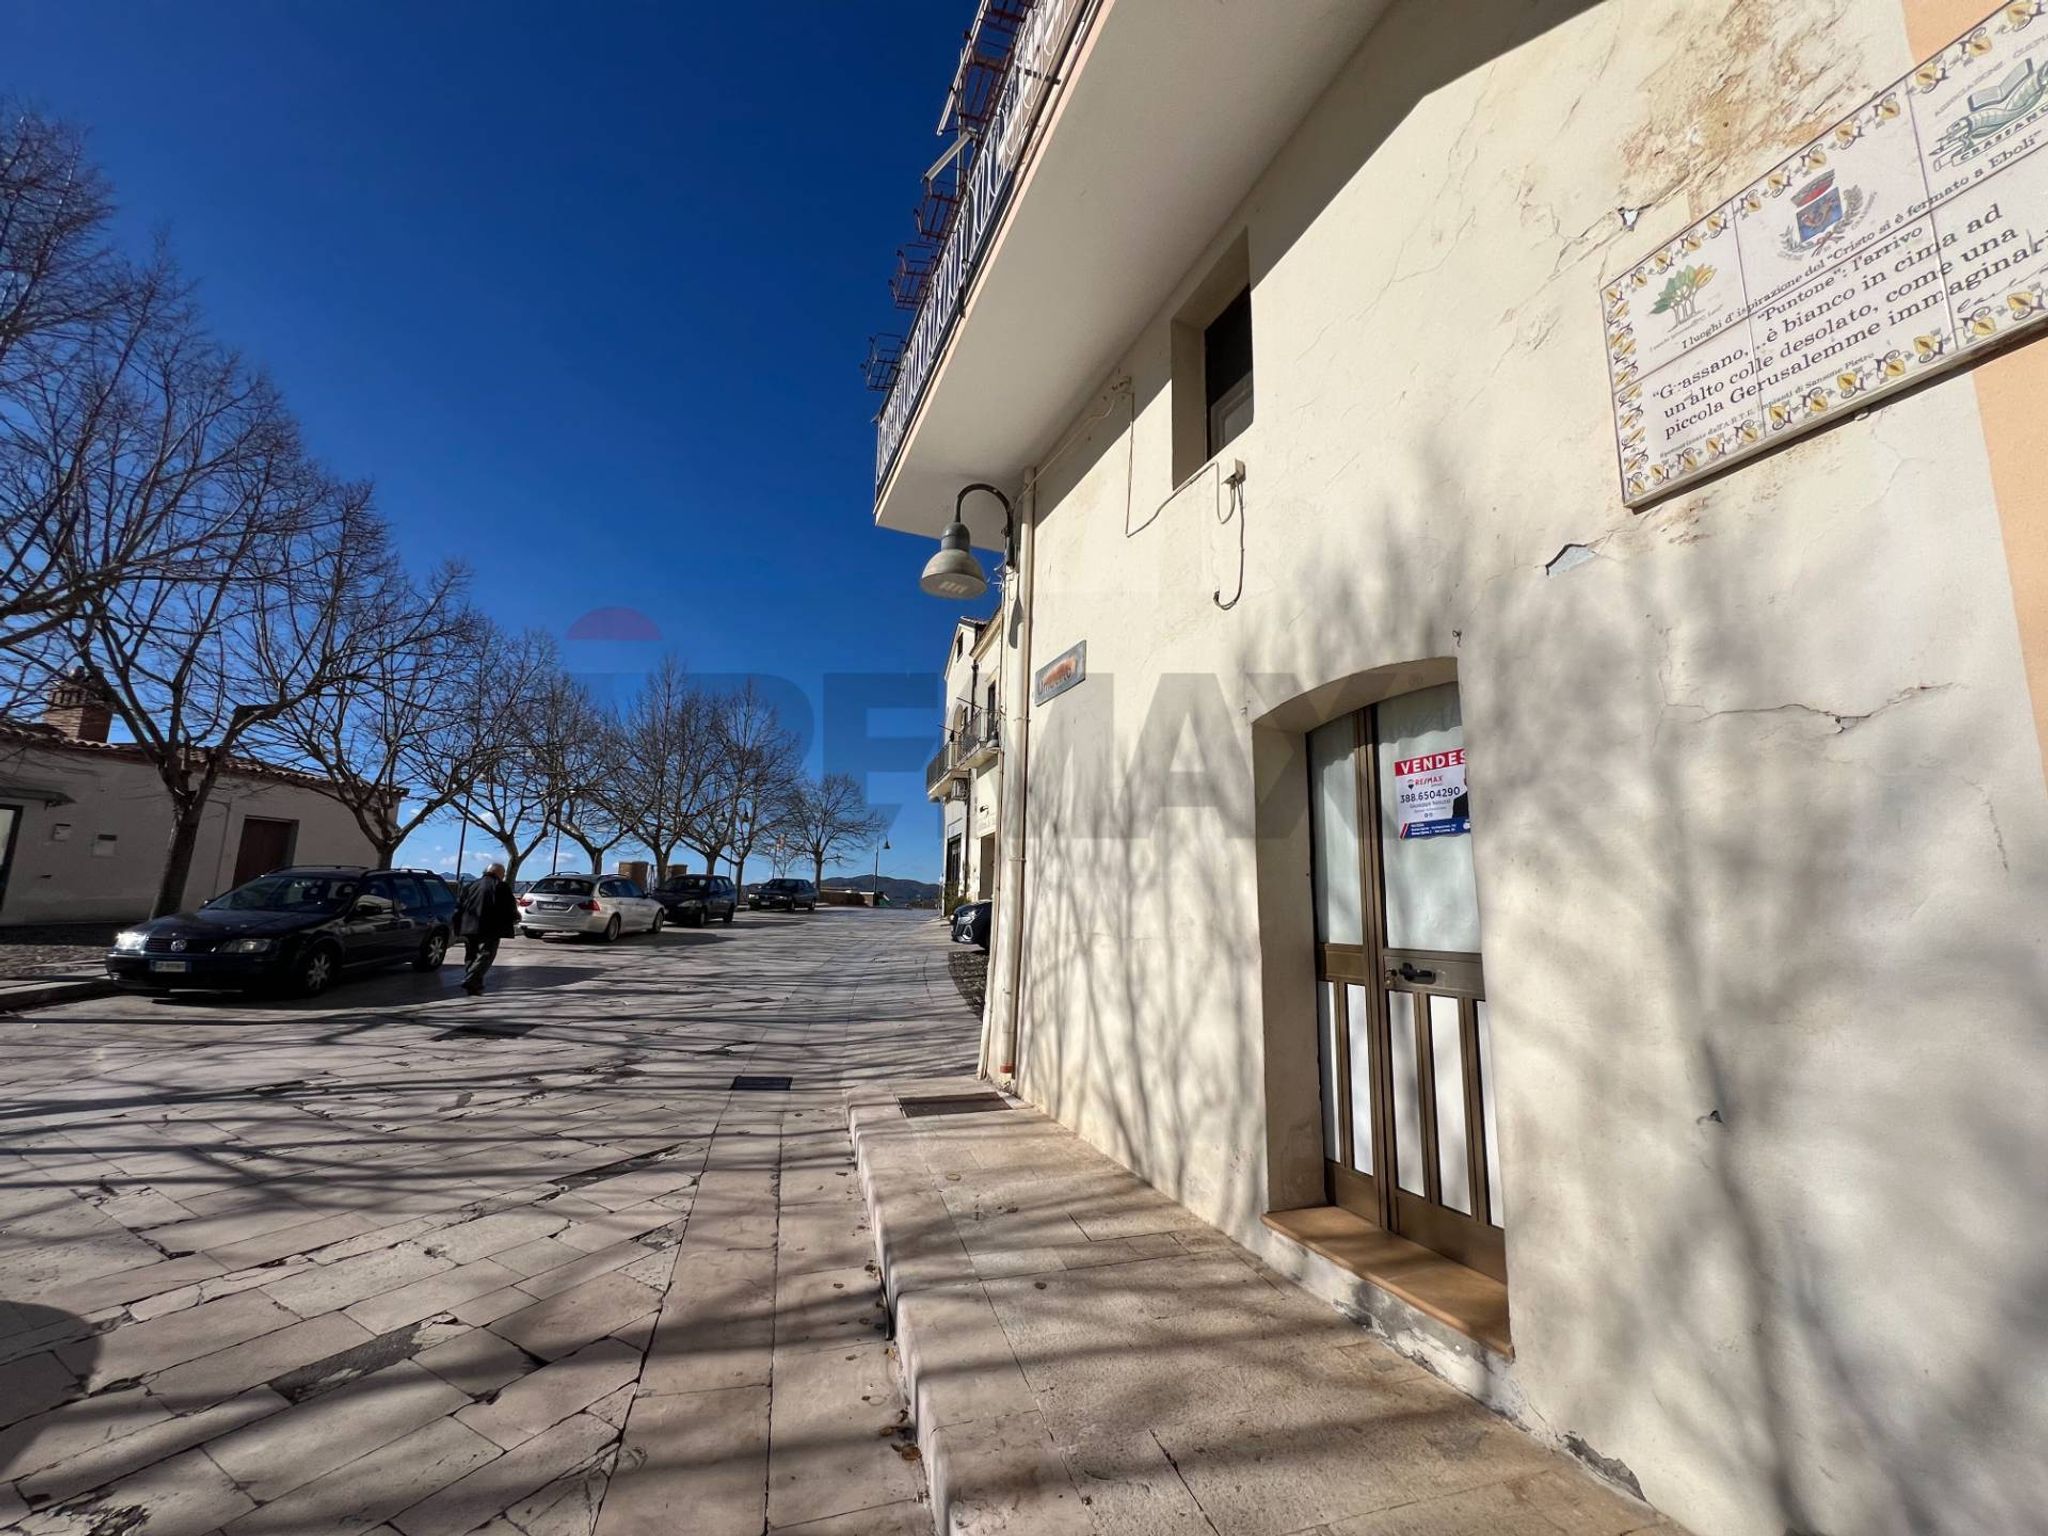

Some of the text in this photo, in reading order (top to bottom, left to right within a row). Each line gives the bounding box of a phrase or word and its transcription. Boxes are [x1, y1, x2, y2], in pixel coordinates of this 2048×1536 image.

[1689, 320, 1723, 345] luoghi
[1737, 274, 1802, 315] ispirazione
[1804, 259, 1825, 277] del
[1879, 219, 1891, 234] si
[1894, 213, 1904, 224] è
[1907, 177, 1970, 217] fermato
[1974, 168, 1984, 178] a
[1729, 355, 1774, 384] colle
[1780, 303, 1879, 358] desolato,
[1886, 262, 1953, 303] come
[1960, 229, 2019, 262] una
[1783, 287, 1855, 334] bianco
[1860, 271, 1887, 291] in
[1894, 232, 1959, 273] cima
[1967, 203, 2003, 234] ad
[1852, 227, 1922, 272] l'arrivo
[1665, 402, 1724, 440] piccola
[1729, 322, 1881, 404] Gerusalemme
